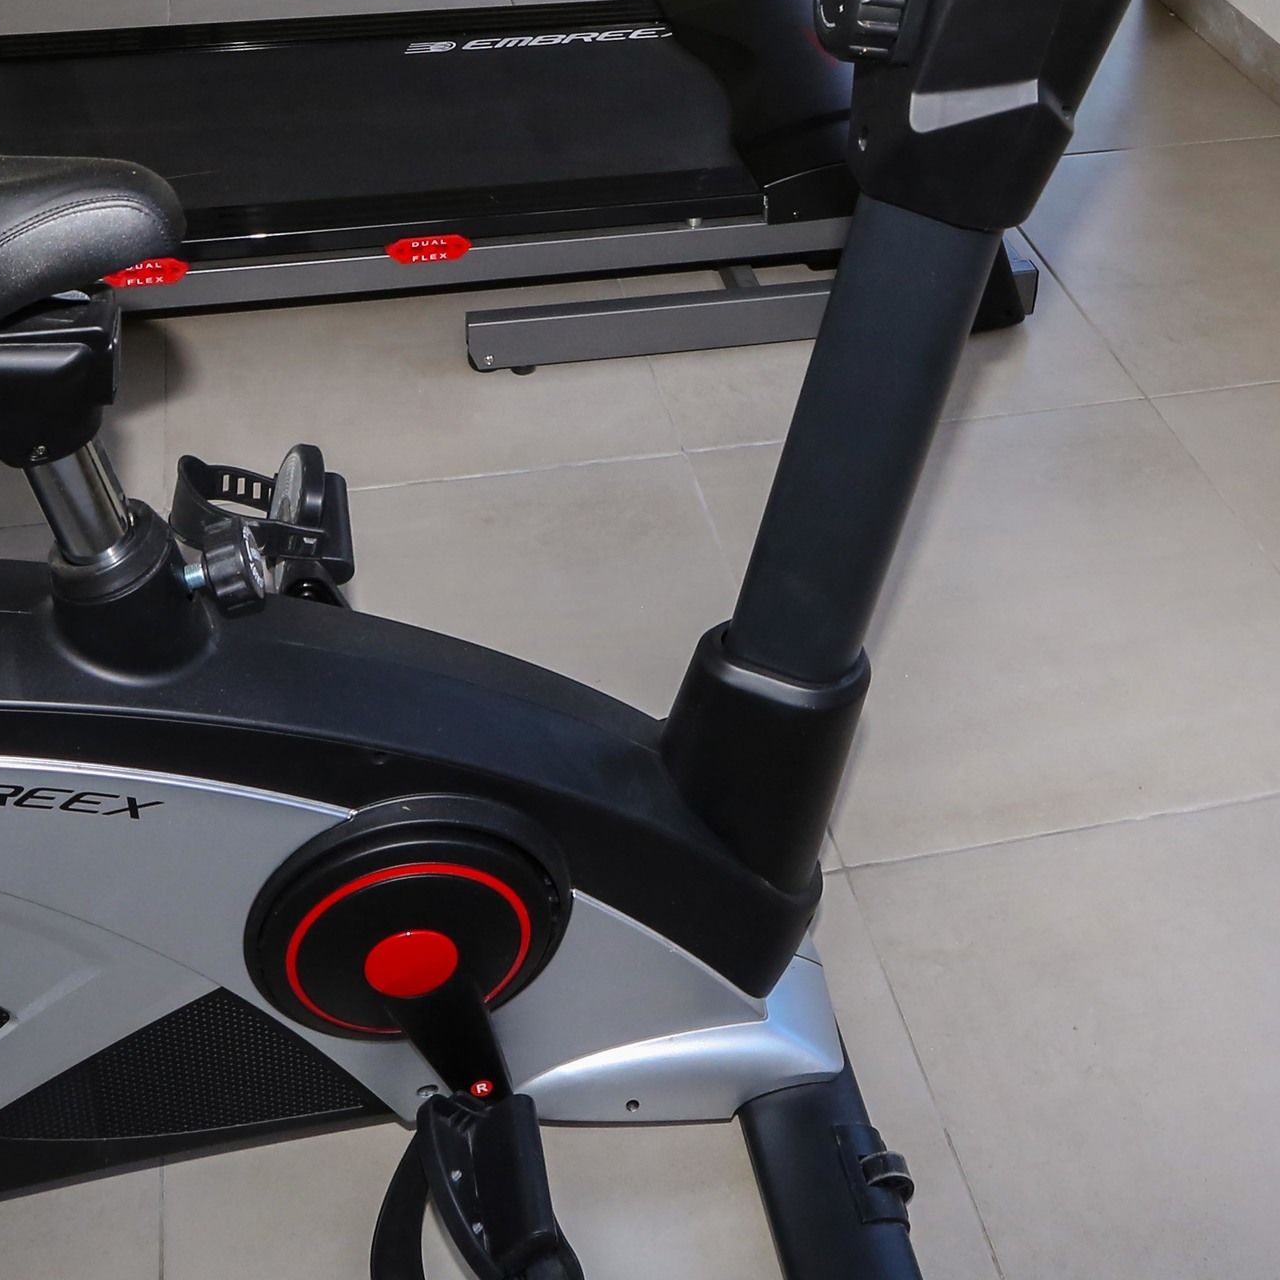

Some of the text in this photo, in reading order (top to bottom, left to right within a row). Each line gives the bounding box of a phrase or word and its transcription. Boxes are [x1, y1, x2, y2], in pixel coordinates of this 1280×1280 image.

[461, 26, 673, 51] EMBREE
[411, 238, 447, 248] DUAL
[412, 251, 448, 262] FLEX
[126, 275, 164, 286] FLEX
[476, 1083, 488, 1094] R
